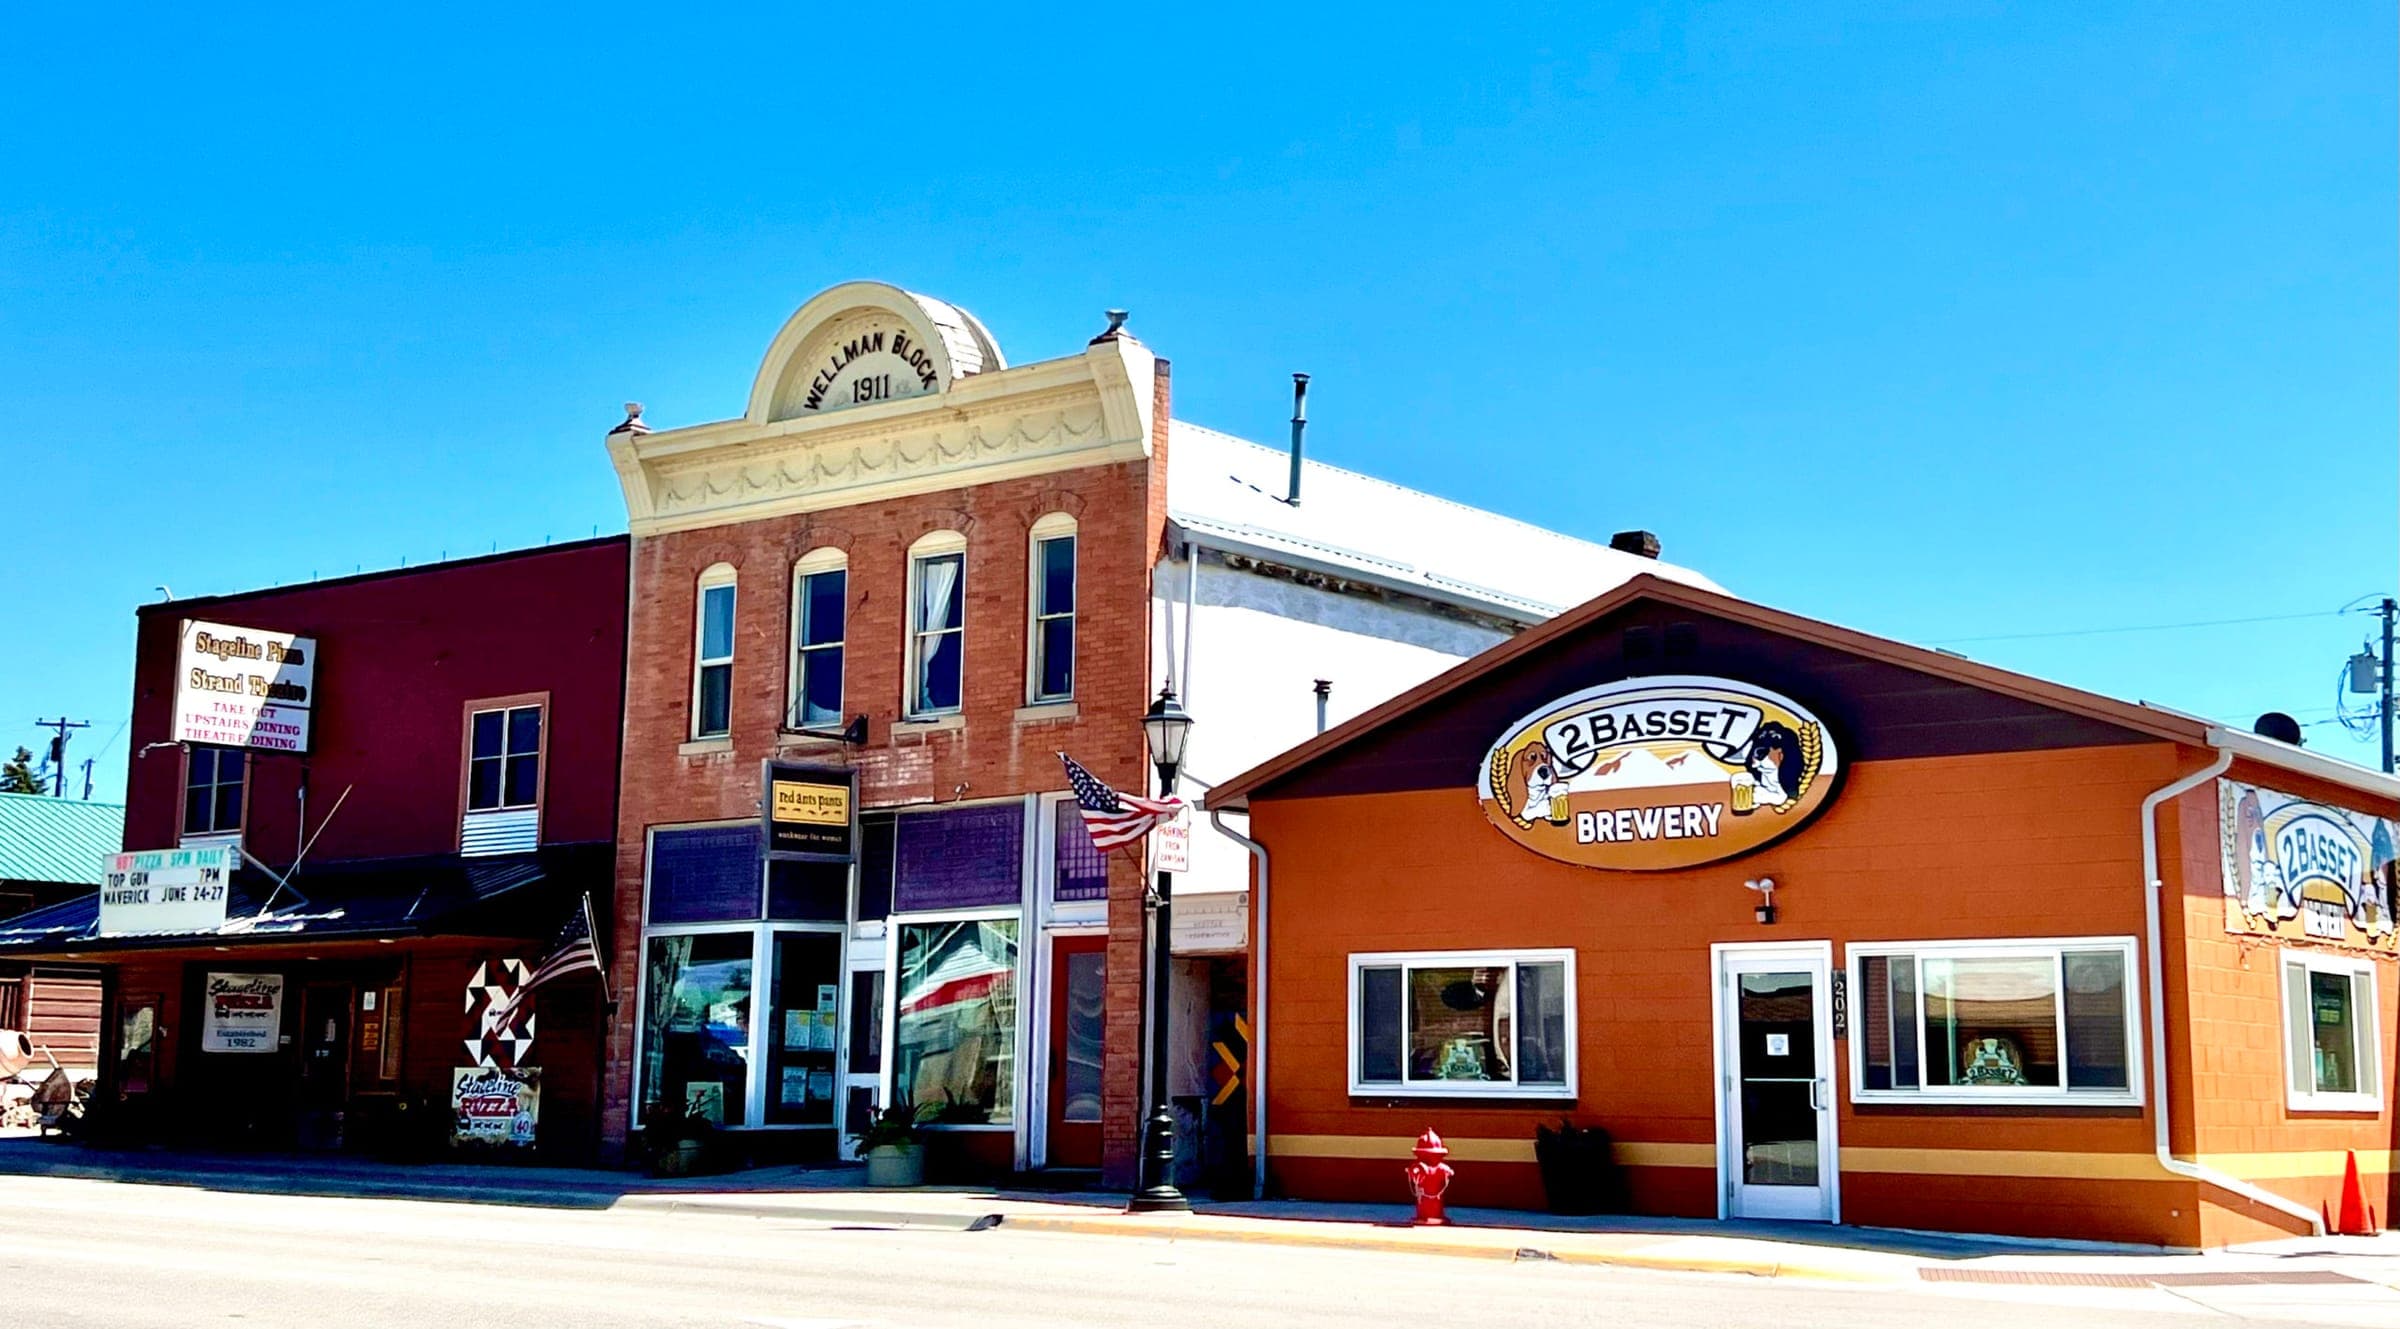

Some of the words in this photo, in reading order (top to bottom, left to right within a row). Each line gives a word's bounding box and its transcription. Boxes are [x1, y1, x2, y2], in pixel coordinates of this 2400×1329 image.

[804, 332, 884, 410] WELLMAN
[892, 333, 938, 391] BLOCK
[852, 374, 890, 403] 1911
[196, 632, 262, 661] Stageline
[191, 668, 243, 694] Strand
[213, 702, 246, 715] TAKE
[252, 707, 276, 719] OUT
[185, 713, 249, 729] UPSTAIRS
[255, 721, 301, 736] DINING
[184, 728, 245, 744] THEATRE
[251, 735, 297, 749] DINING
[779, 790, 795, 803] red
[796, 792, 817, 805] ants
[818, 795, 843, 811] pants
[1576, 803, 1724, 844] BREWERY
[196, 849, 225, 866] DAILY
[108, 873, 125, 888] TOP
[130, 871, 149, 887] GUN
[200, 868, 220, 885] 7PM
[104, 889, 149, 905] MAVERICK
[161, 887, 187, 902] JUNE
[193, 886, 223, 901] 24-27
[1834, 981, 1846, 1028] 202
[216, 1029, 267, 1038] Established
[226, 1038, 256, 1048] 1982
[516, 1121, 529, 1134] 40
